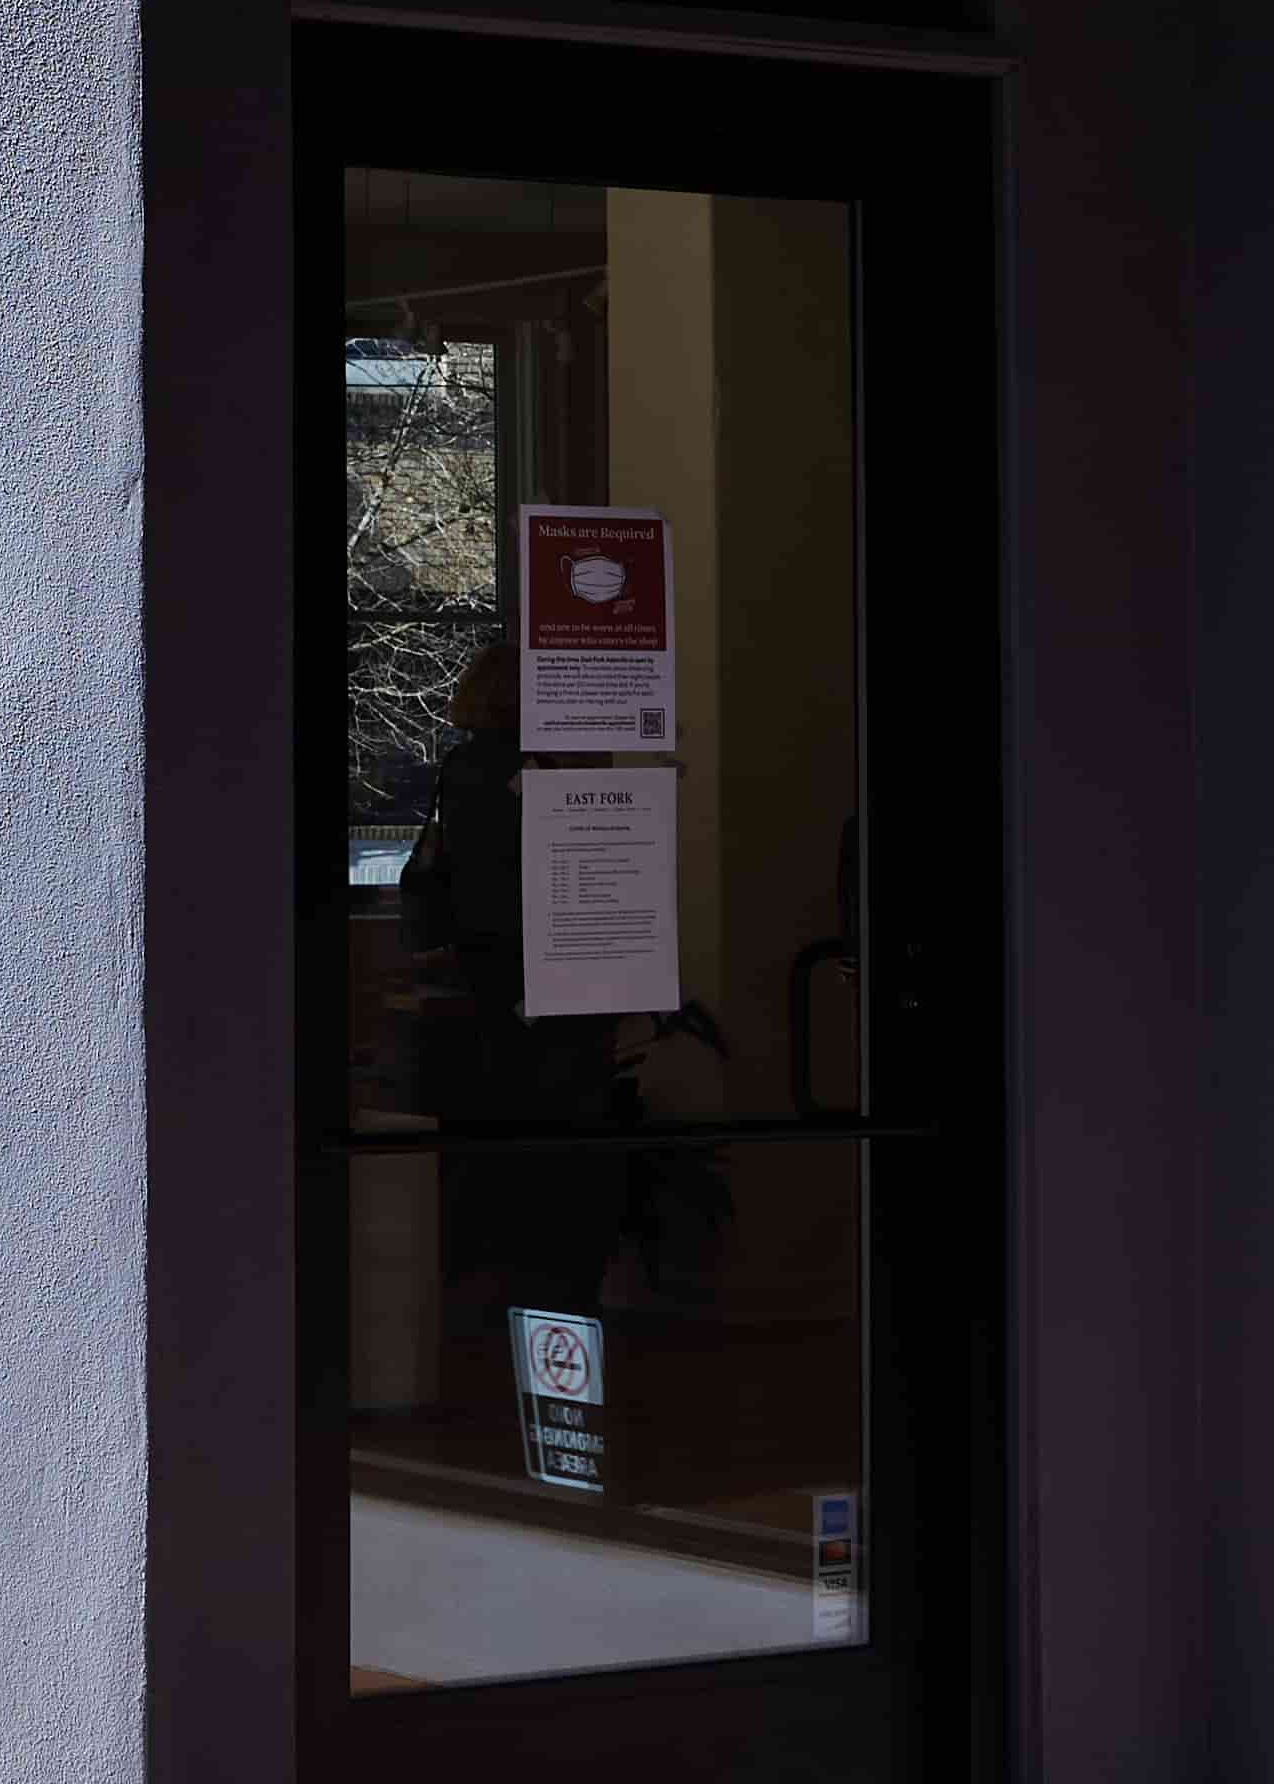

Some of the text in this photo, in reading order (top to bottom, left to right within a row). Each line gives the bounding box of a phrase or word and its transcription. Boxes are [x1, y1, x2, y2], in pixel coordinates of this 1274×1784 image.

[538, 523, 655, 543] Masks are Required
[566, 791, 633, 806] EAST FORK
